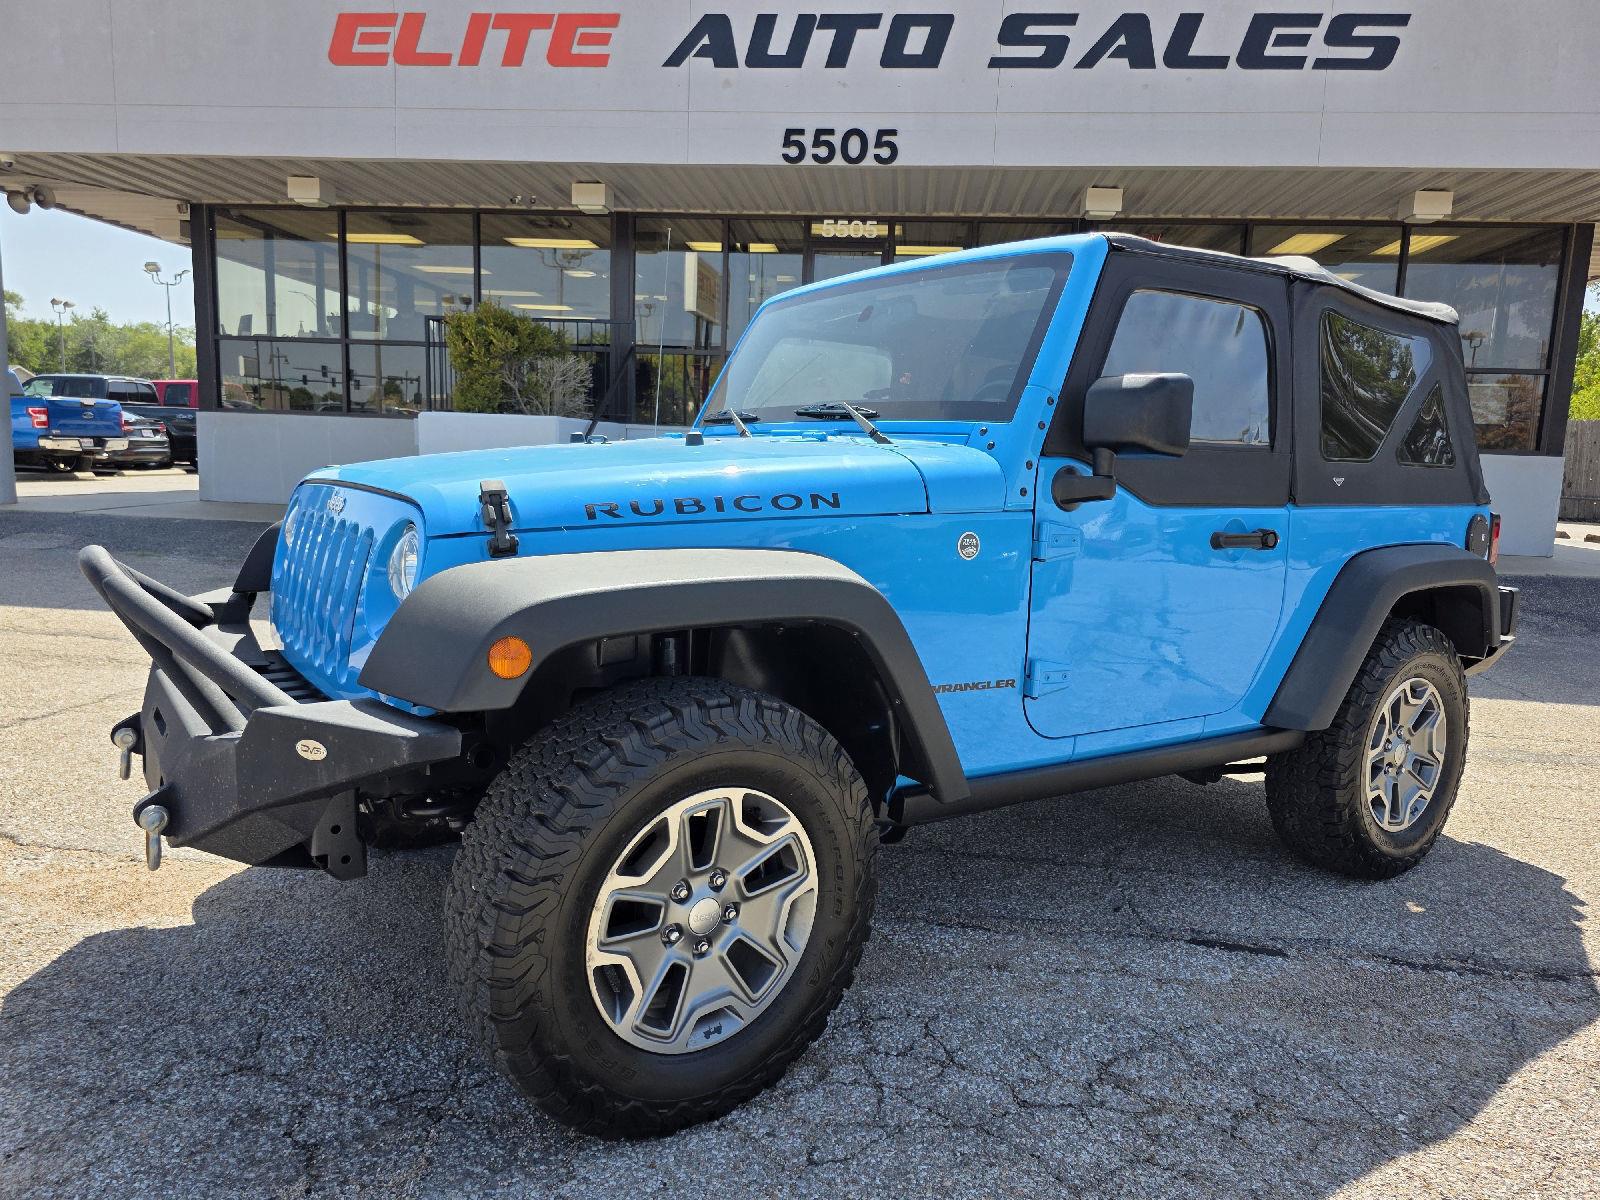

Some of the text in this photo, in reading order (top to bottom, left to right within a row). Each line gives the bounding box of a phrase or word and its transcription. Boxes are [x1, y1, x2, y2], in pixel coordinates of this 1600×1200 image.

[328, 12, 1412, 70] ELITE AUTO SALES
[781, 128, 899, 165] 5505
[822, 219, 878, 239] 5505
[584, 492, 841, 521] RUBICON
